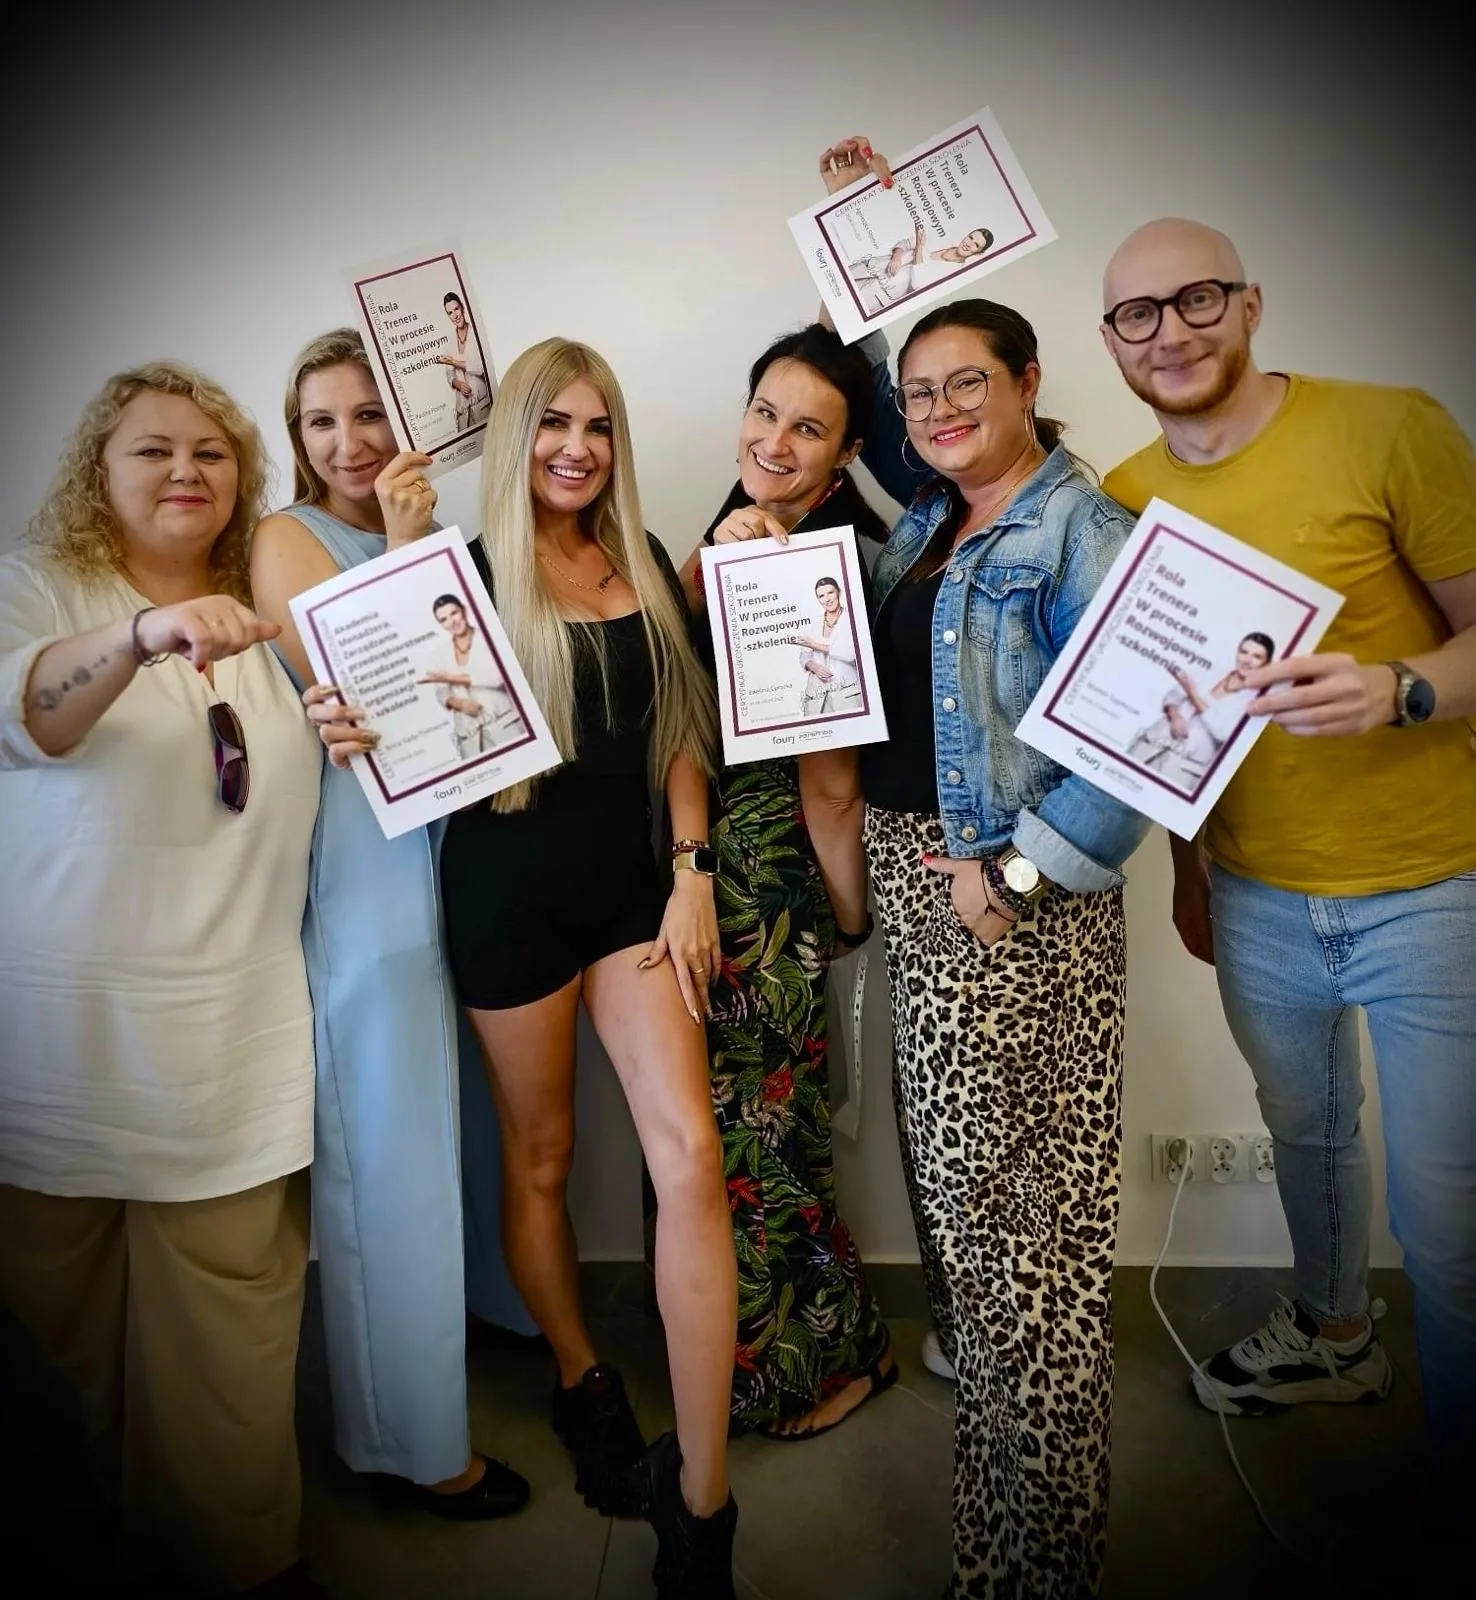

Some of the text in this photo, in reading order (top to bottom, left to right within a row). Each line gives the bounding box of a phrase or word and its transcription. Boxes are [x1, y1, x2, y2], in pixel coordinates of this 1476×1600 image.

[953, 153, 969, 175] Rola
[925, 167, 956, 220] W procesie
[939, 160, 963, 199] Trenera
[834, 189, 877, 217] CERTYFIKAT
[910, 175, 946, 238] Rozwojowym
[378, 301, 398, 315] Rola
[383, 312, 418, 330] Trenera
[388, 323, 434, 346] W procesie
[394, 334, 448, 362] Rozwojowym
[735, 581, 758, 593] Rola
[1155, 564, 1187, 588] Rola
[724, 573, 736, 616] SZKOLENIA
[737, 593, 778, 607] Trenera
[1146, 581, 1199, 618] Trenera
[334, 611, 379, 635] Akademia
[739, 604, 797, 622] W procesie
[741, 617, 811, 637] Rozwojowym
[1135, 598, 1208, 646] W procesie
[1124, 615, 1213, 671] Rozwojowym
[358, 667, 416, 696] finansami w
[365, 681, 416, 709] organizacji
[736, 671, 748, 716] CERTYFIKAT
[375, 694, 419, 718] szkolenie
